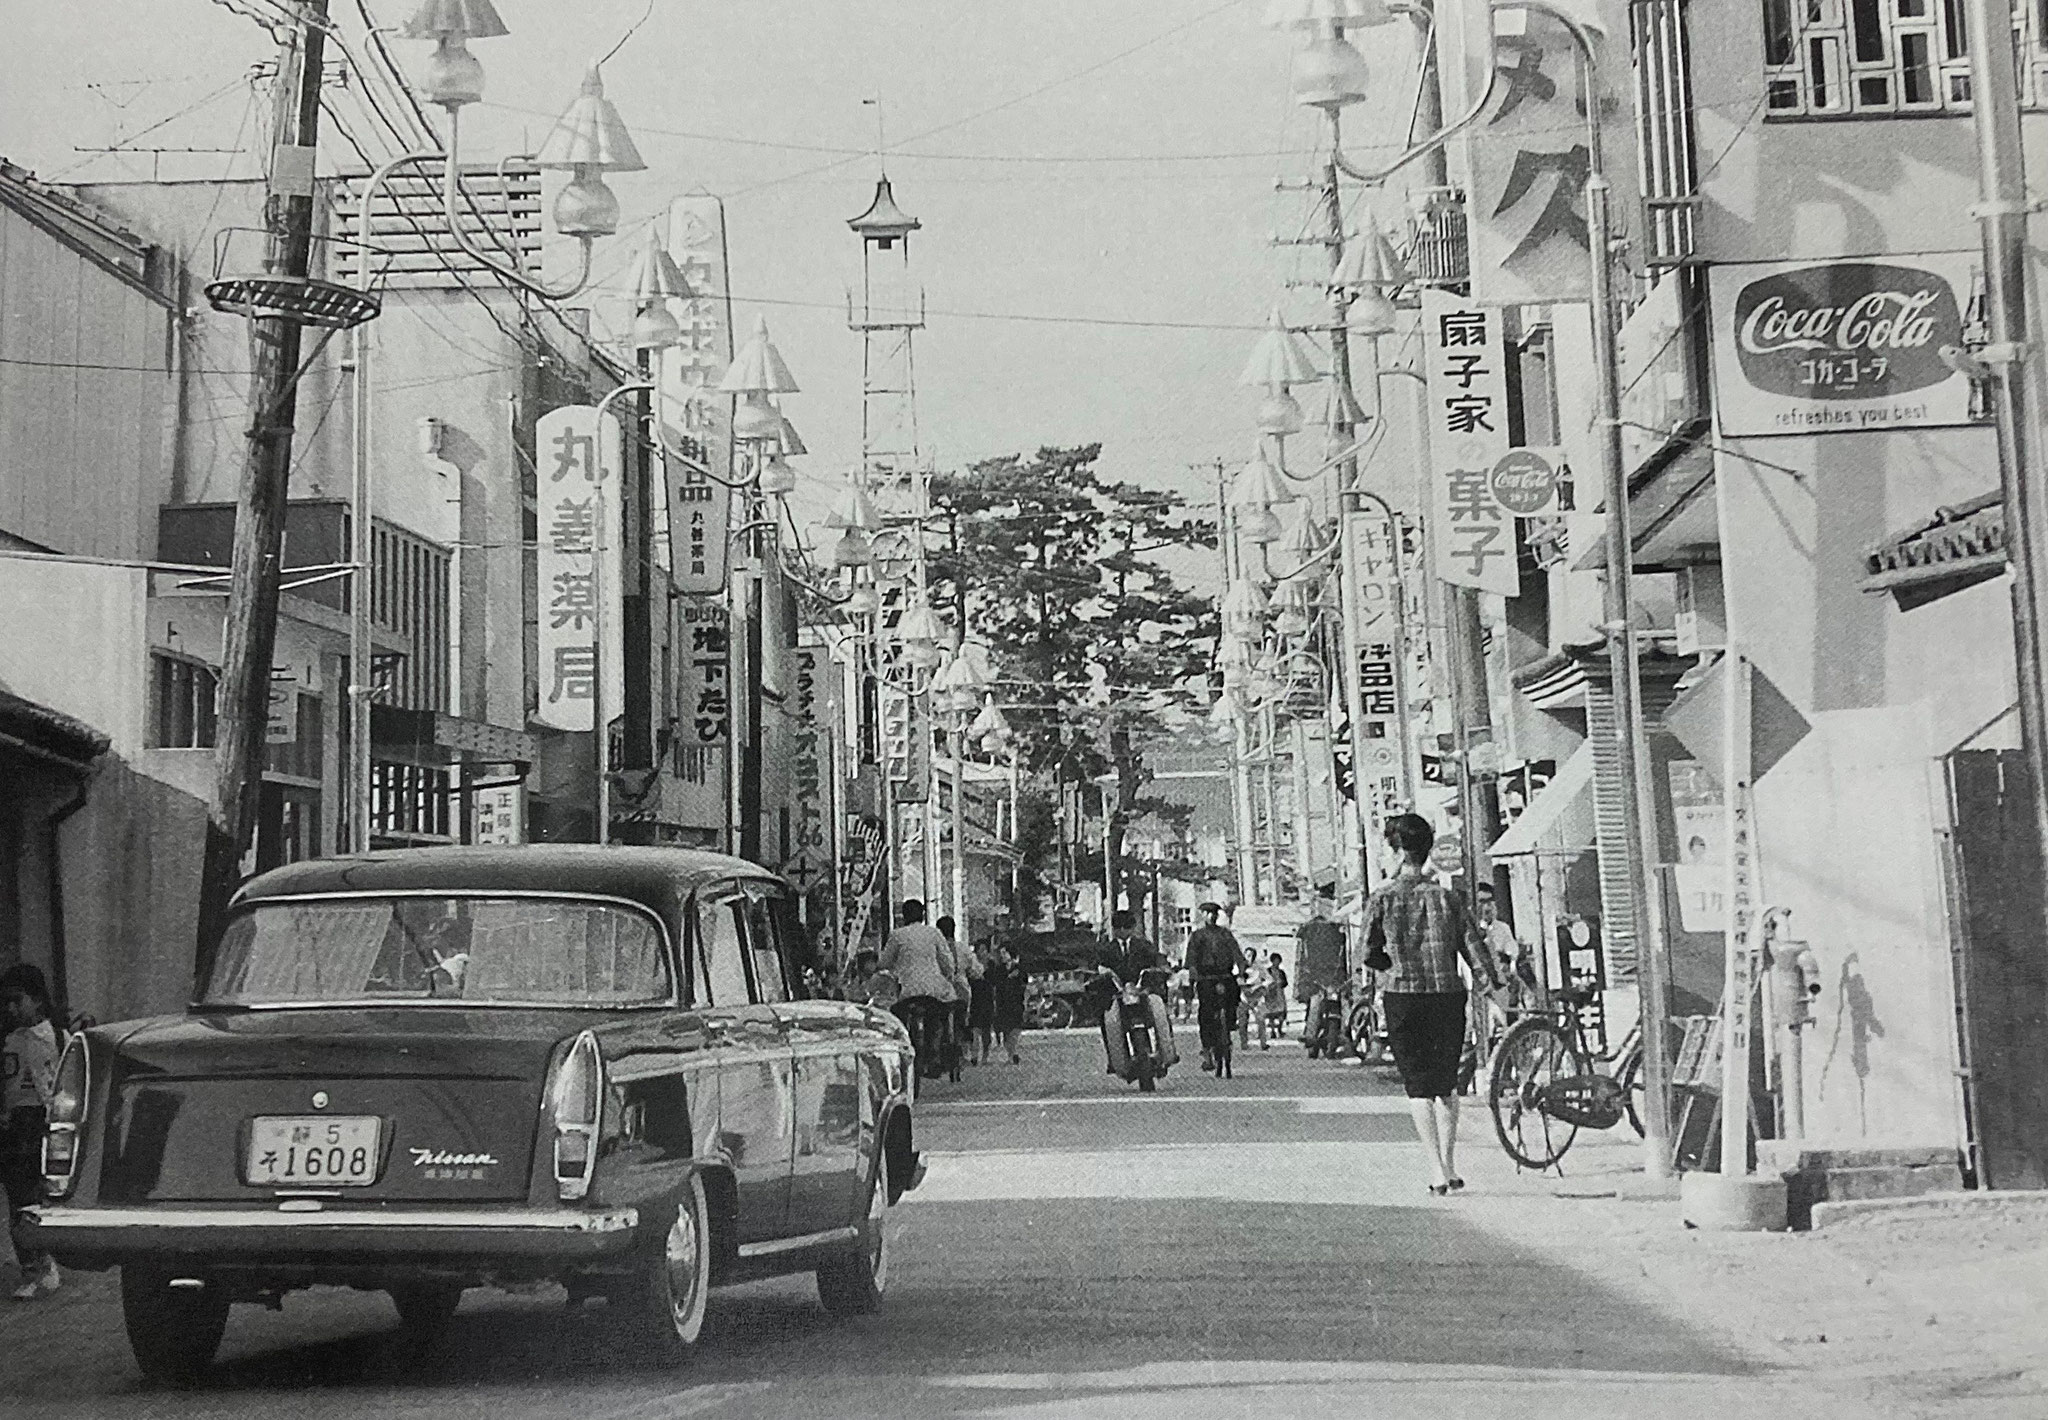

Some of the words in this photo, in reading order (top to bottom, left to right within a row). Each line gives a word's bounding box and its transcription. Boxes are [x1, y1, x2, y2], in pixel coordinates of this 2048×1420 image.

[1776, 406, 1852, 426] refreshes
[1859, 408, 1888, 426] you
[1895, 403, 1928, 421] best
[549, 426, 610, 703] 丸善薬局
[326, 1124, 342, 1145] 5
